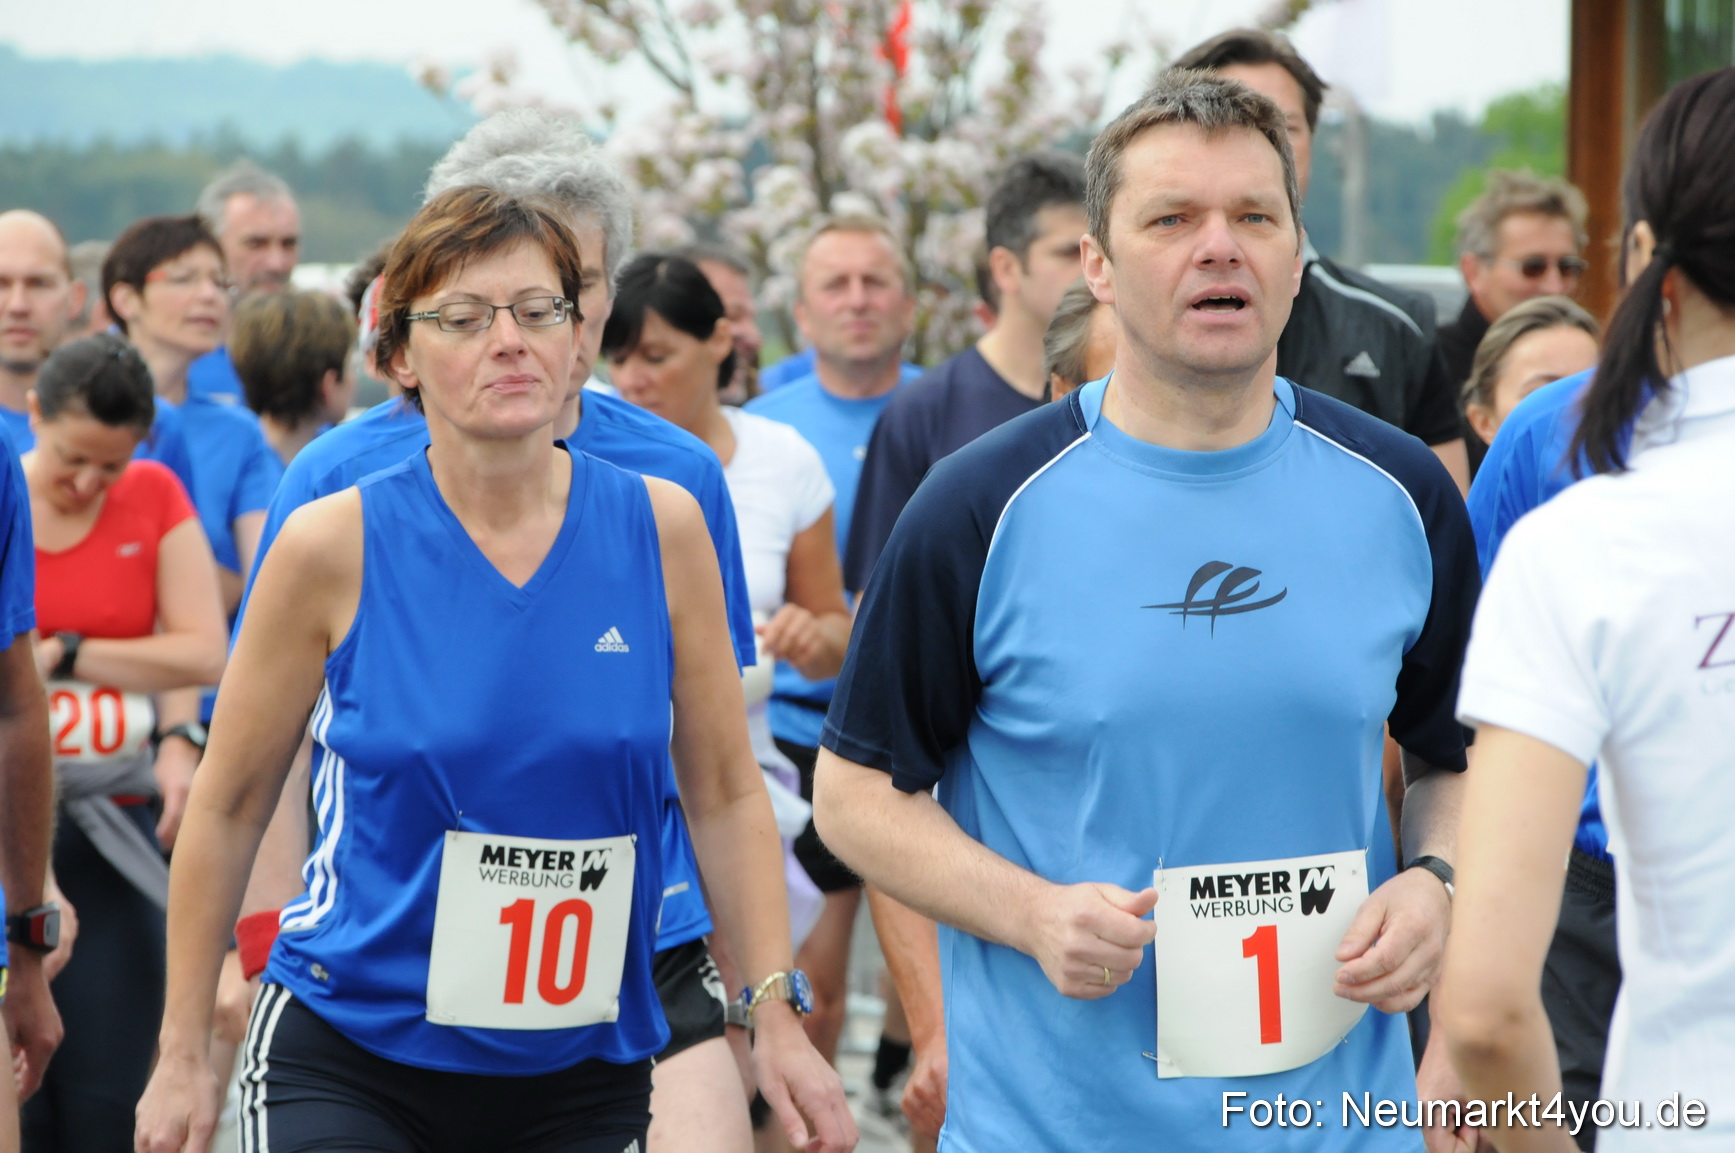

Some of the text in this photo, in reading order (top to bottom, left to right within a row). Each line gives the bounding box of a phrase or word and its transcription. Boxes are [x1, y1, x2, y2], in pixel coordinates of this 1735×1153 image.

[594, 643, 630, 653] adidas
[50, 687, 126, 755] 20
[479, 844, 576, 872] MEYER
[478, 867, 575, 889] WERBUNG
[1189, 870, 1293, 901] MEYER
[1190, 896, 1294, 919] WERBUNG
[499, 898, 593, 1006] 10
[1242, 924, 1283, 1045] 1
